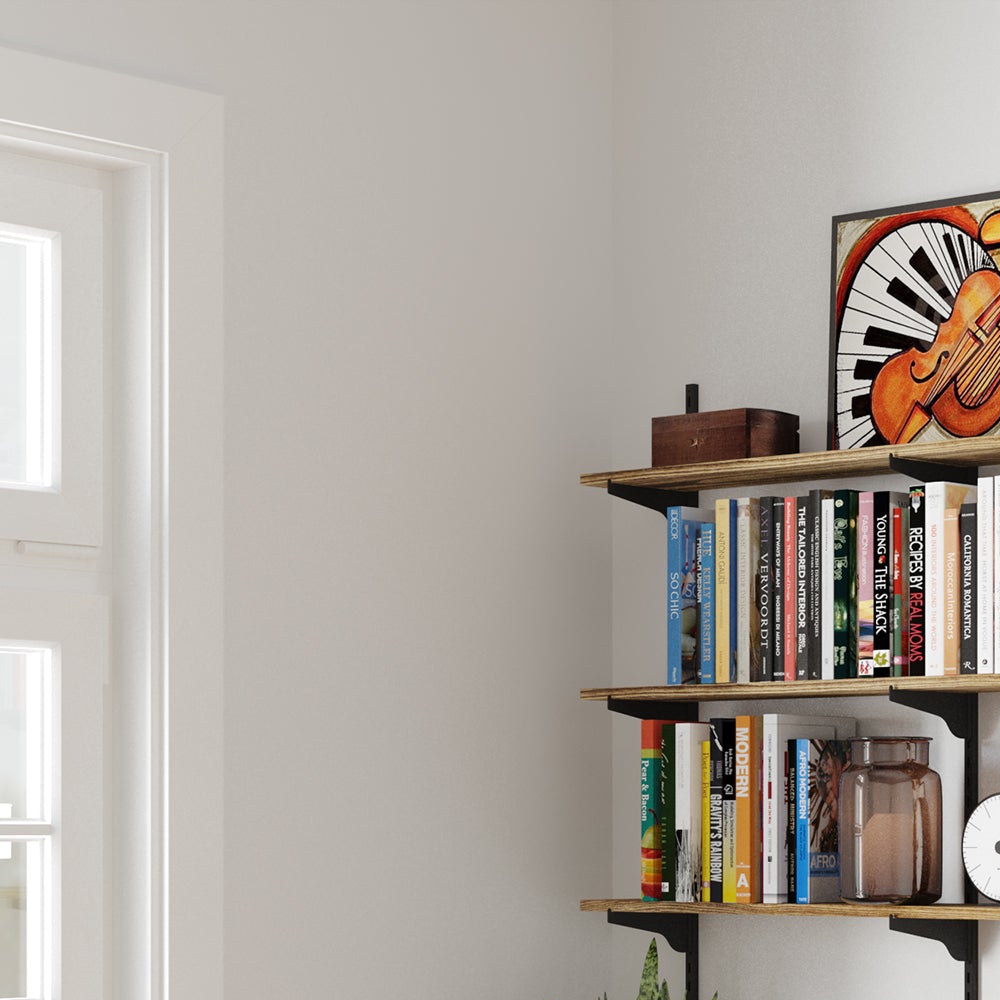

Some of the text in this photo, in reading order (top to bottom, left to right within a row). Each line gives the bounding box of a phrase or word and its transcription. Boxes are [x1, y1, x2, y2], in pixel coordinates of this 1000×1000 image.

[717, 532, 725, 559] ANTONI
[760, 506, 769, 649] AXEL VERVOORDT
[775, 558, 781, 566] OF
[798, 506, 806, 628] THE TAILORED INTERIOR
[876, 515, 887, 635] YOUNG THE SHACK
[670, 572, 679, 620] SO CHIC
[702, 530, 712, 661] HUE KELLY WEARSTLER
[910, 527, 923, 662] RECIPES BY REAL MOMS
[963, 535, 972, 640] CALIFORNIA ROMANTICA
[641, 760, 649, 783] Pear
[736, 727, 749, 797] MODERN
[799, 750, 807, 819] AFRO MODERN
[641, 793, 649, 821] Bacon
[710, 794, 722, 883] GRAVITY'S RAINBOW
[736, 873, 749, 888] A
[810, 855, 836, 868] AFRO
